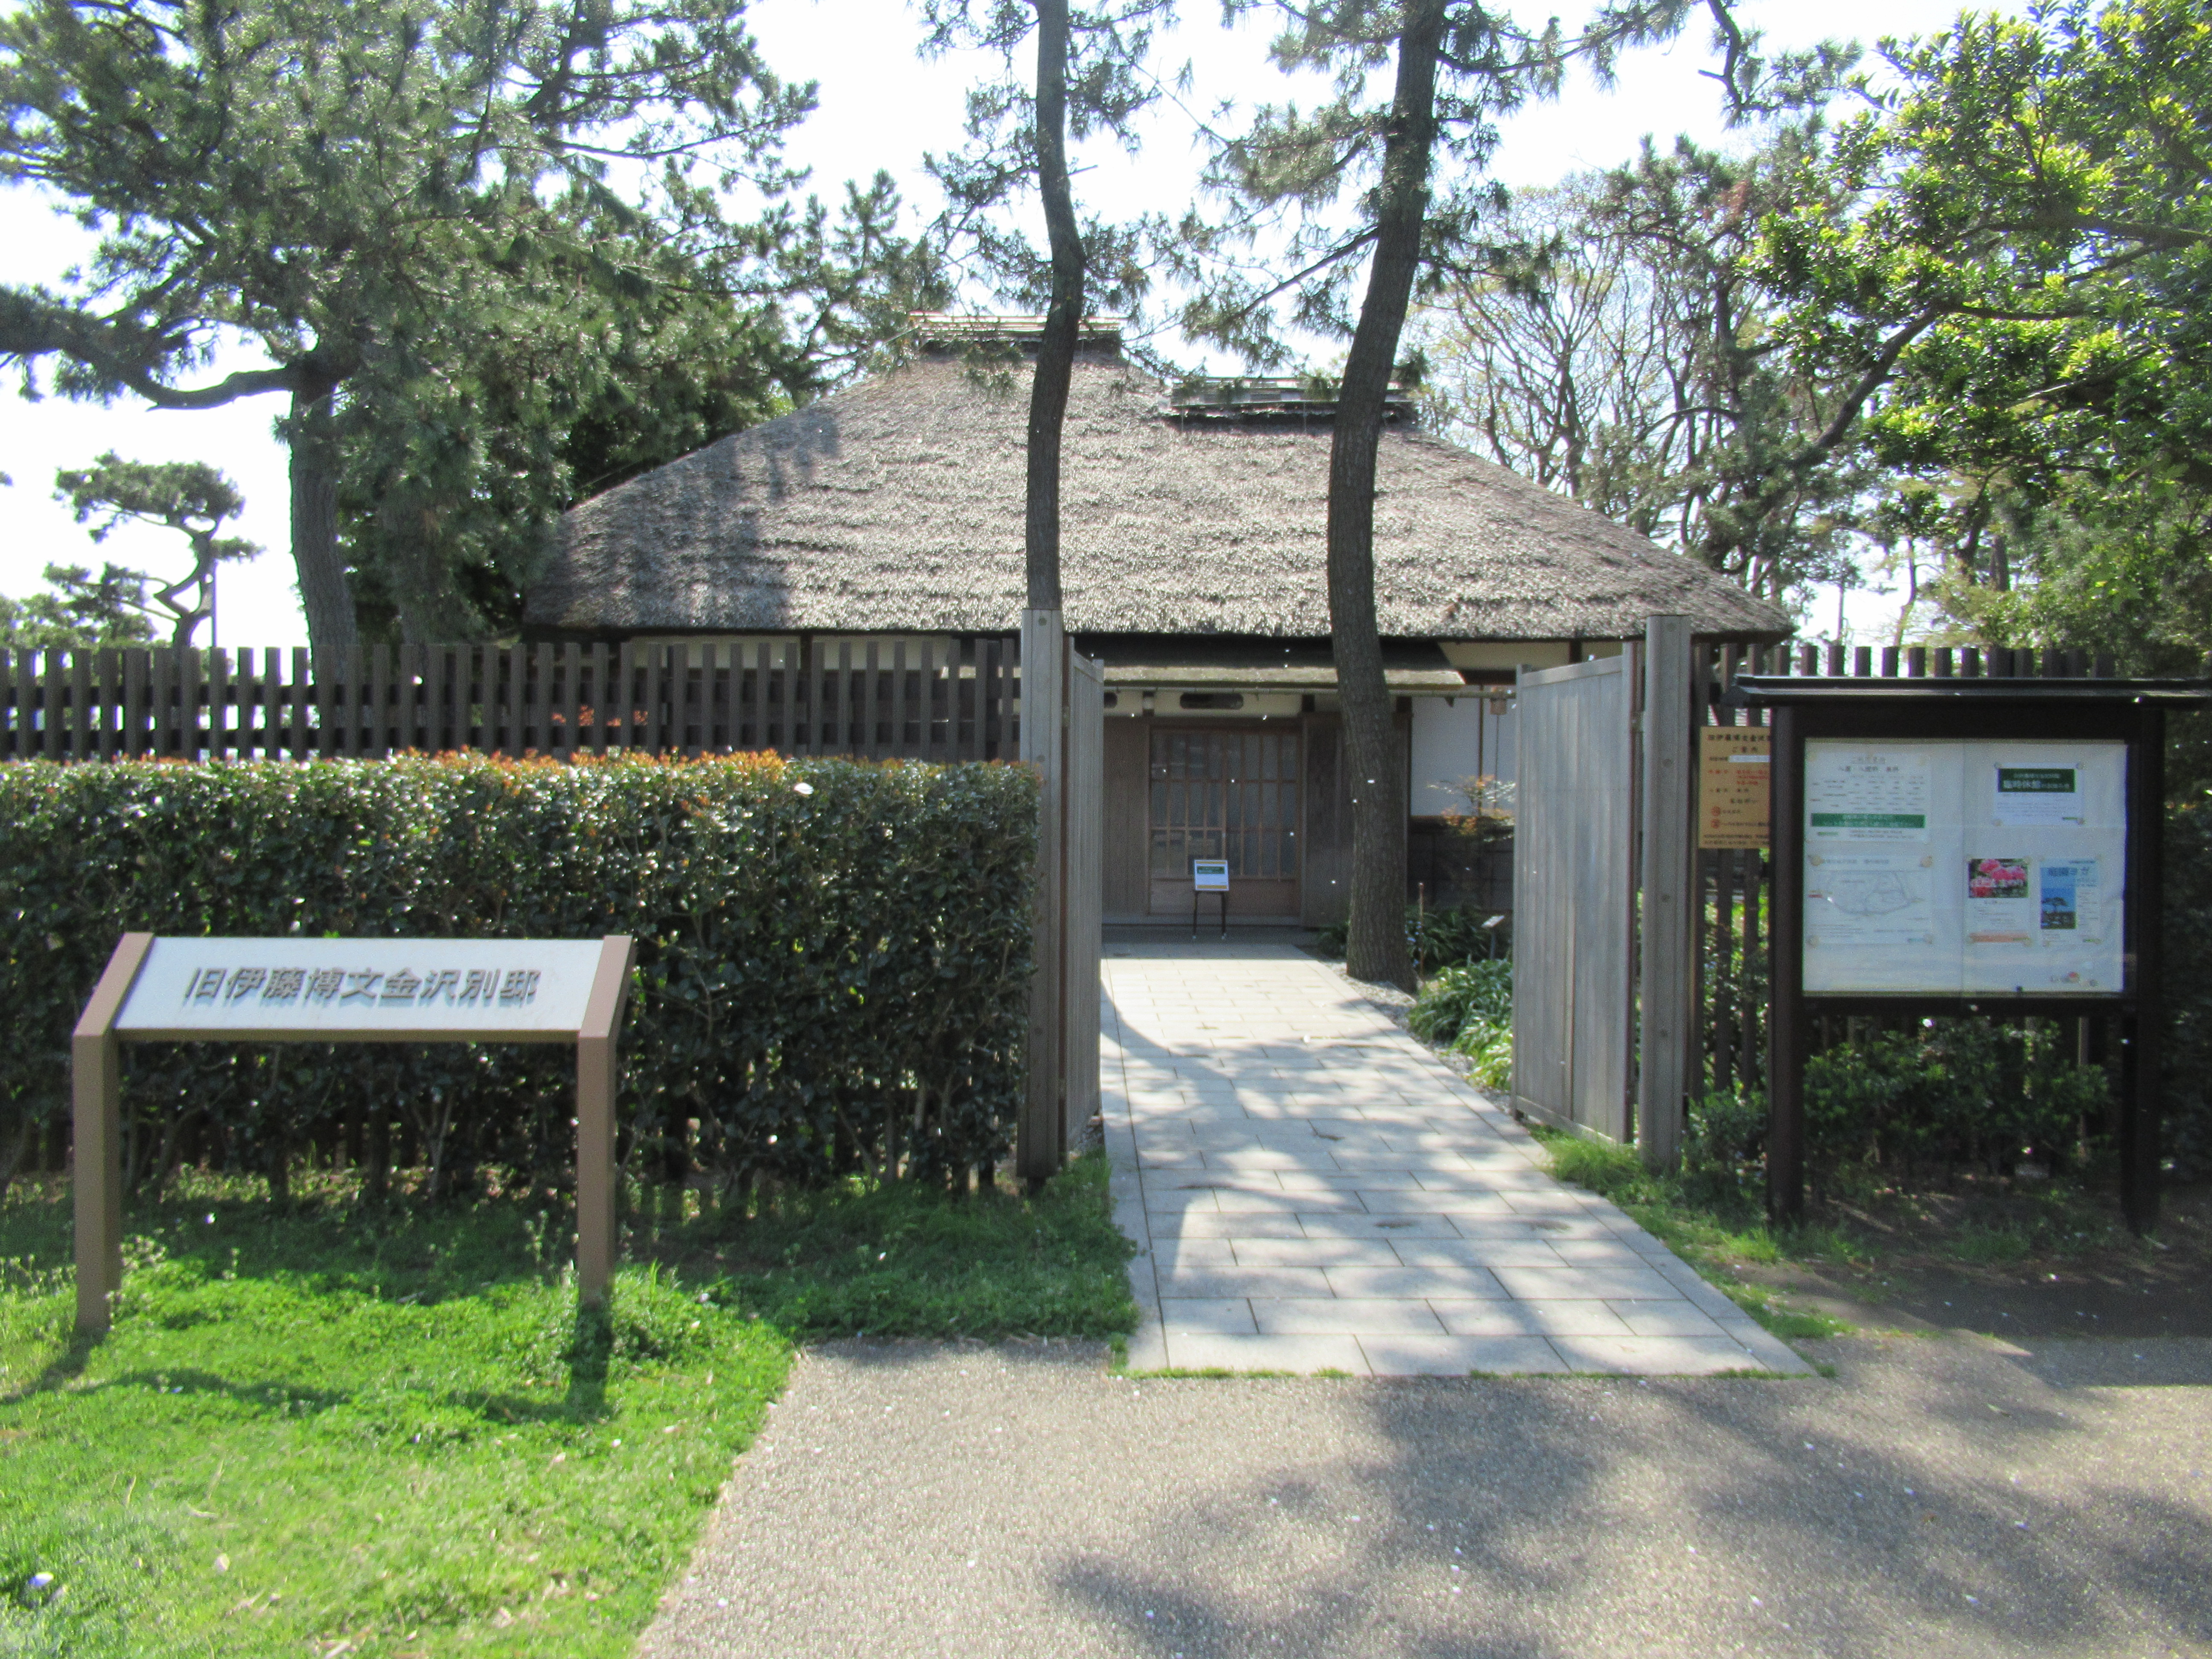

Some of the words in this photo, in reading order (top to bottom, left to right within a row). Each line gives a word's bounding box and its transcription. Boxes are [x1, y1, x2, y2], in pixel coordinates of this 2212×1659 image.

[185, 967, 540, 1002] 旧伊藤博文金沢別邸
